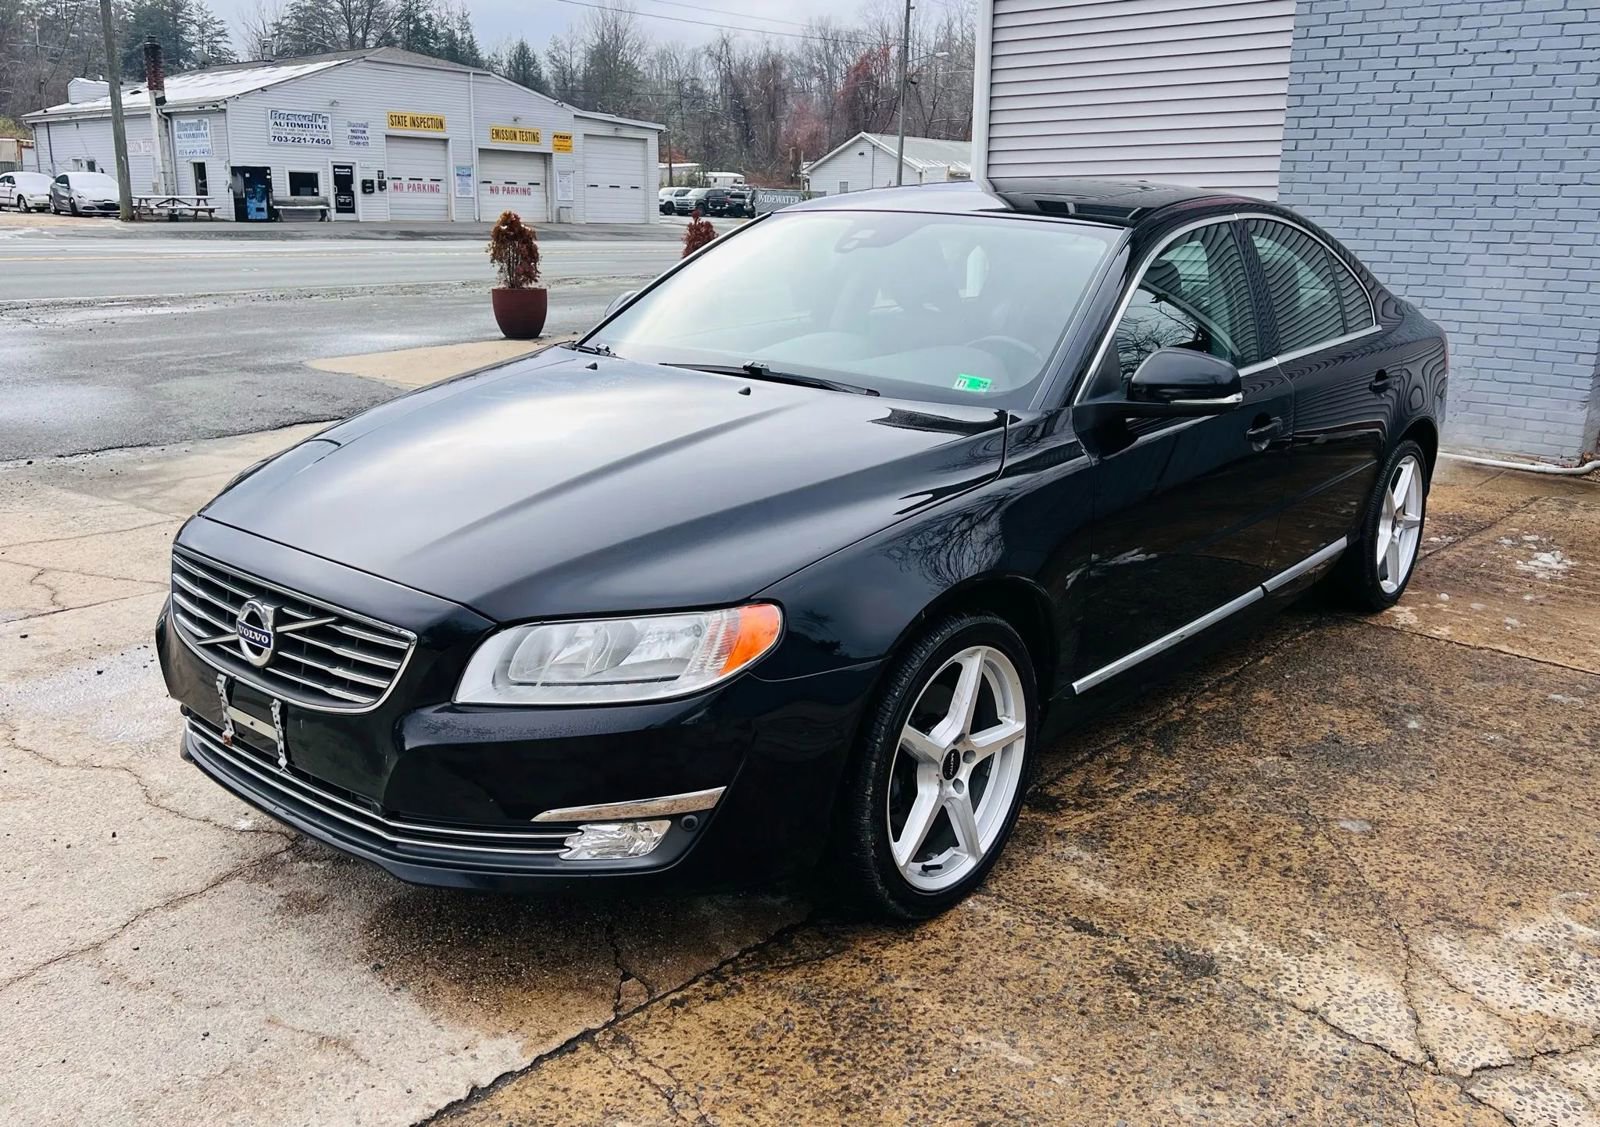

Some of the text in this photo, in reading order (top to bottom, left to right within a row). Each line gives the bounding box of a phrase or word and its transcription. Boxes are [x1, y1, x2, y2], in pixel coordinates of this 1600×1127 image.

[272, 121, 328, 130] AUTOMOTIVE
[389, 114, 445, 130] STATE INSPECTION
[271, 135, 332, 145] 703-221-7450
[491, 128, 540, 143] EMISSION TESTING
[393, 182, 440, 193] NO PARKING
[489, 186, 532, 196] NO PARKING
[758, 194, 800, 204] WIDEWATER
[238, 624, 269, 643] VOLVO
